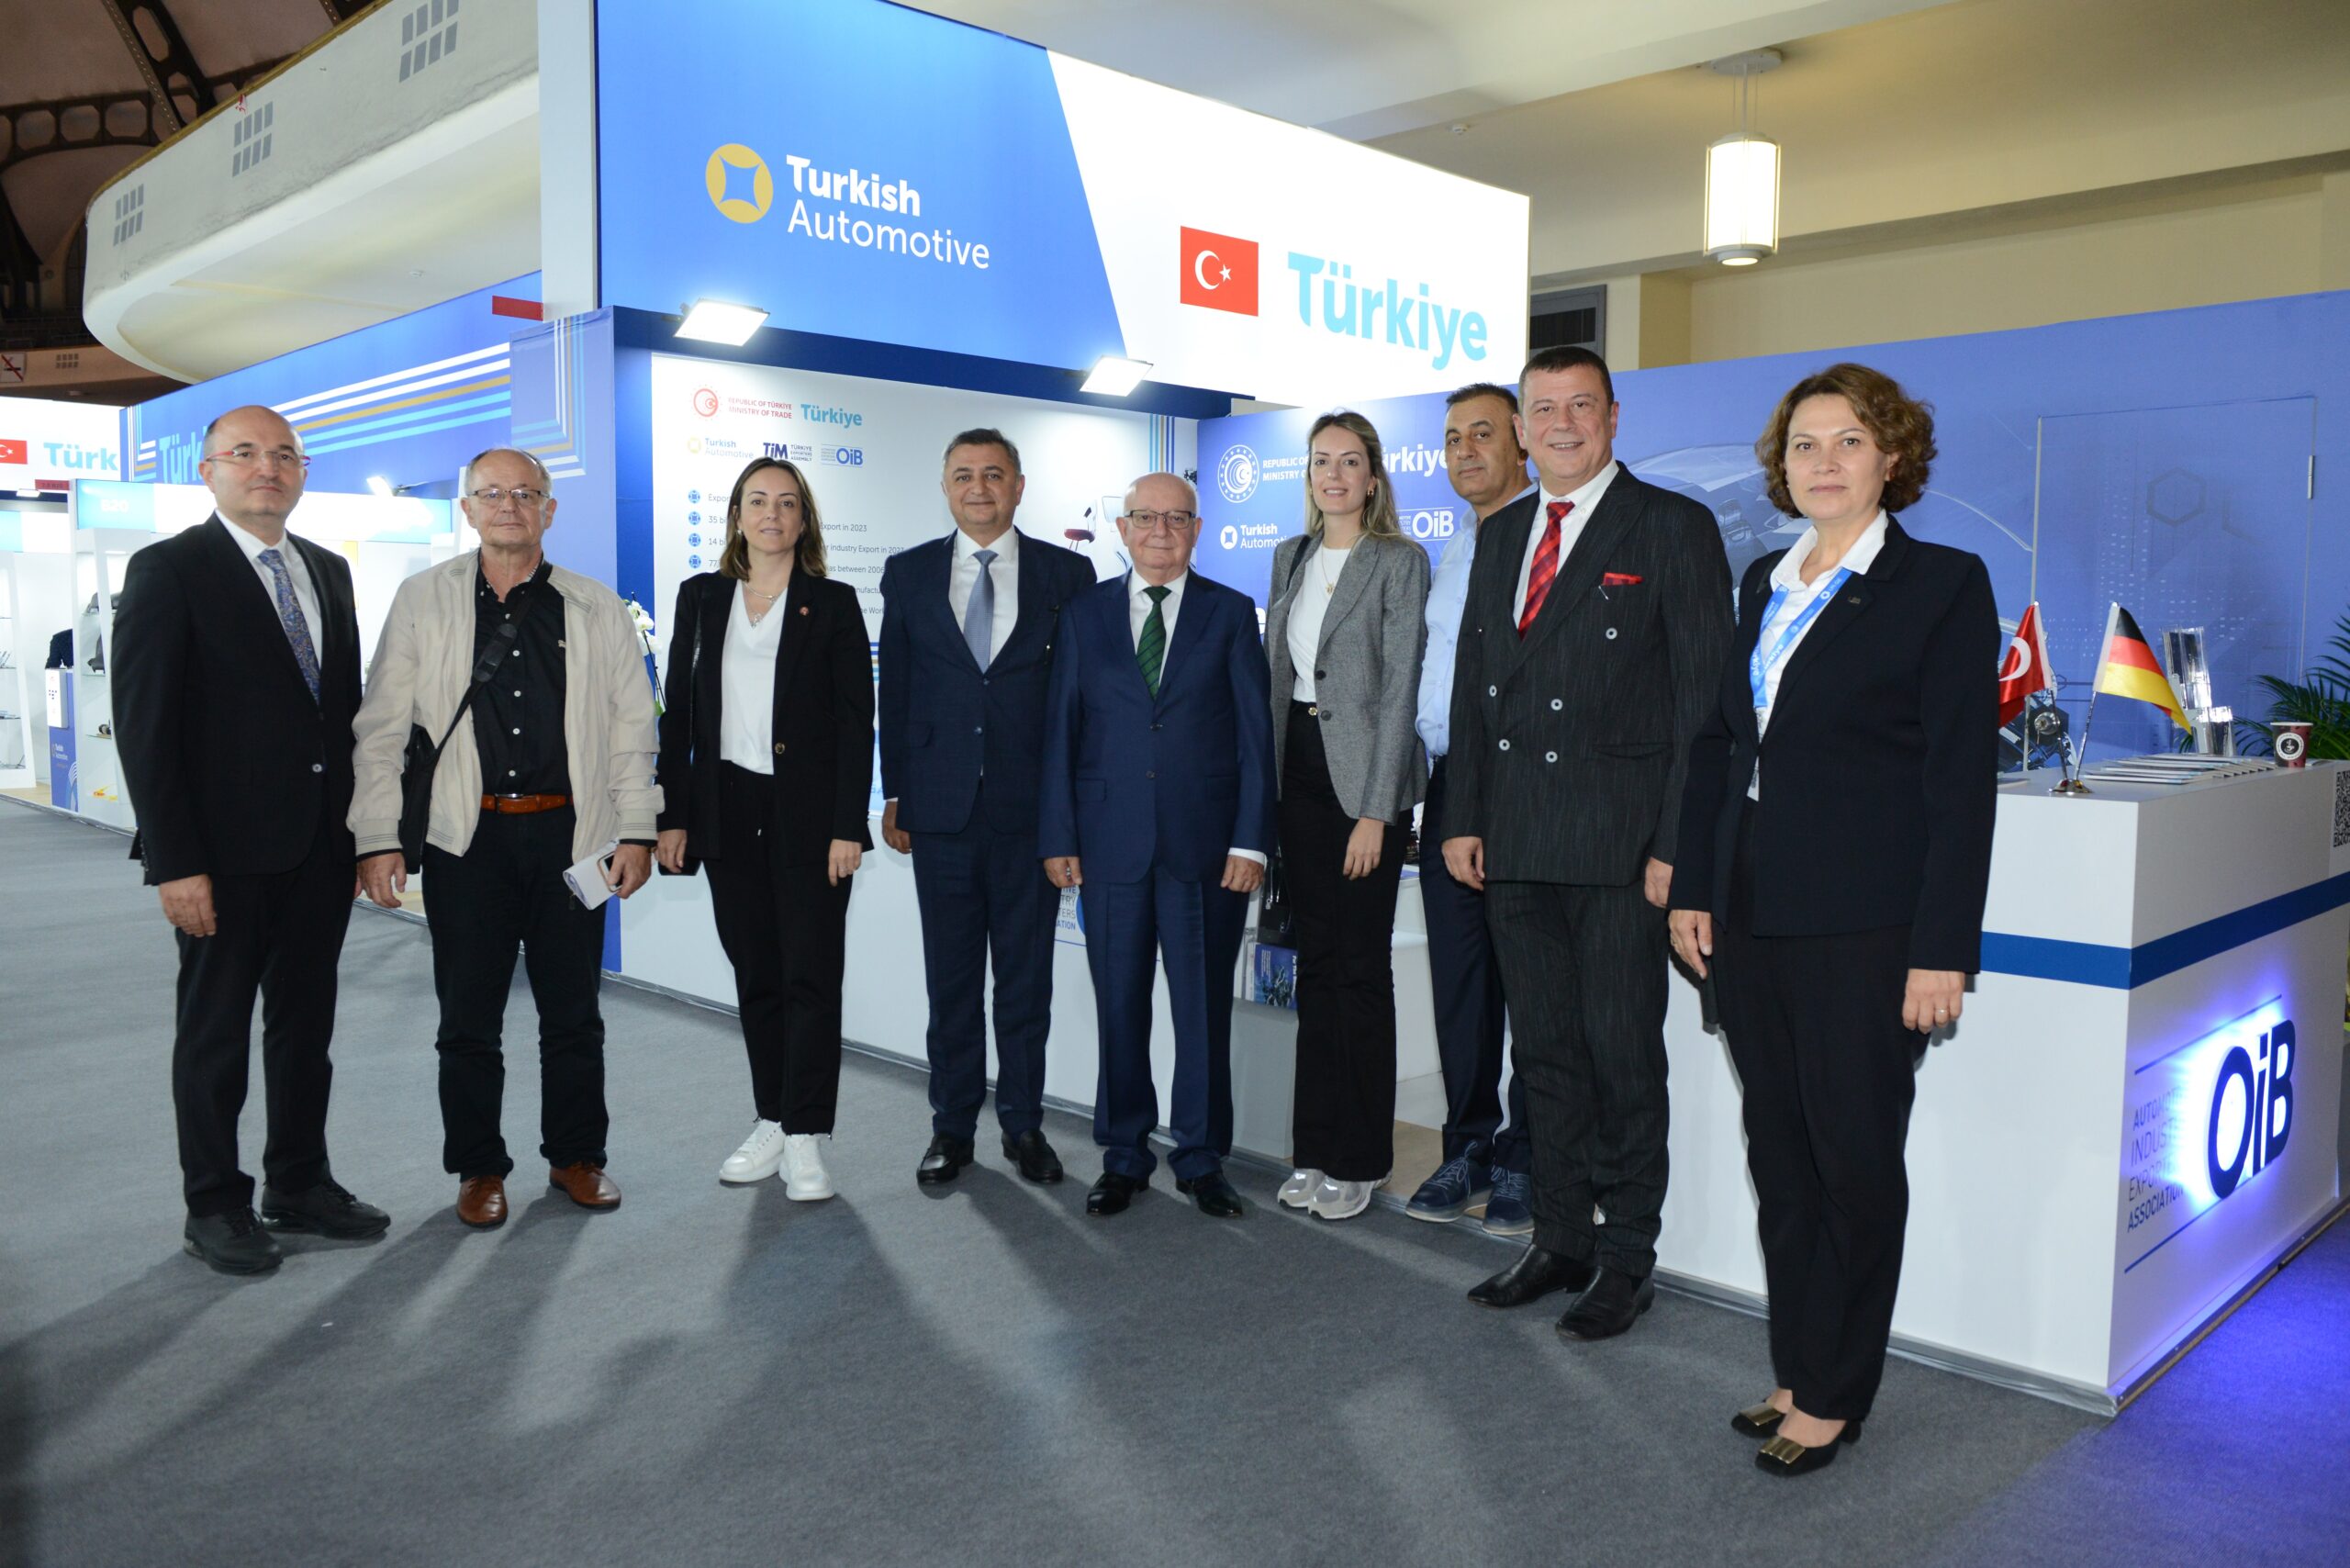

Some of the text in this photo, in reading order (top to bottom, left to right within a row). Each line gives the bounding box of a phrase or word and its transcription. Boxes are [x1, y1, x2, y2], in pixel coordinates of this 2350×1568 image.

[786, 154, 920, 217] Turkish
[788, 199, 990, 269] Automotive
[1288, 252, 1487, 370] Türkiye
[728, 398, 757, 407] REPUBLIC
[729, 406, 760, 416] MINISTRY
[770, 410, 792, 419] TRADE
[800, 404, 863, 429] Türkiye
[705, 438, 736, 448] Turkish
[159, 426, 207, 484] Türk
[705, 447, 754, 459] Automotive
[1262, 458, 1298, 469] REPUBLIC
[1262, 470, 1299, 481] MINISTRY
[850, 523, 867, 532] 2023
[1240, 523, 1278, 536] Turkish
[830, 544, 856, 554] industry
[858, 544, 879, 554] Export
[2208, 1019, 2295, 1199] OiB
